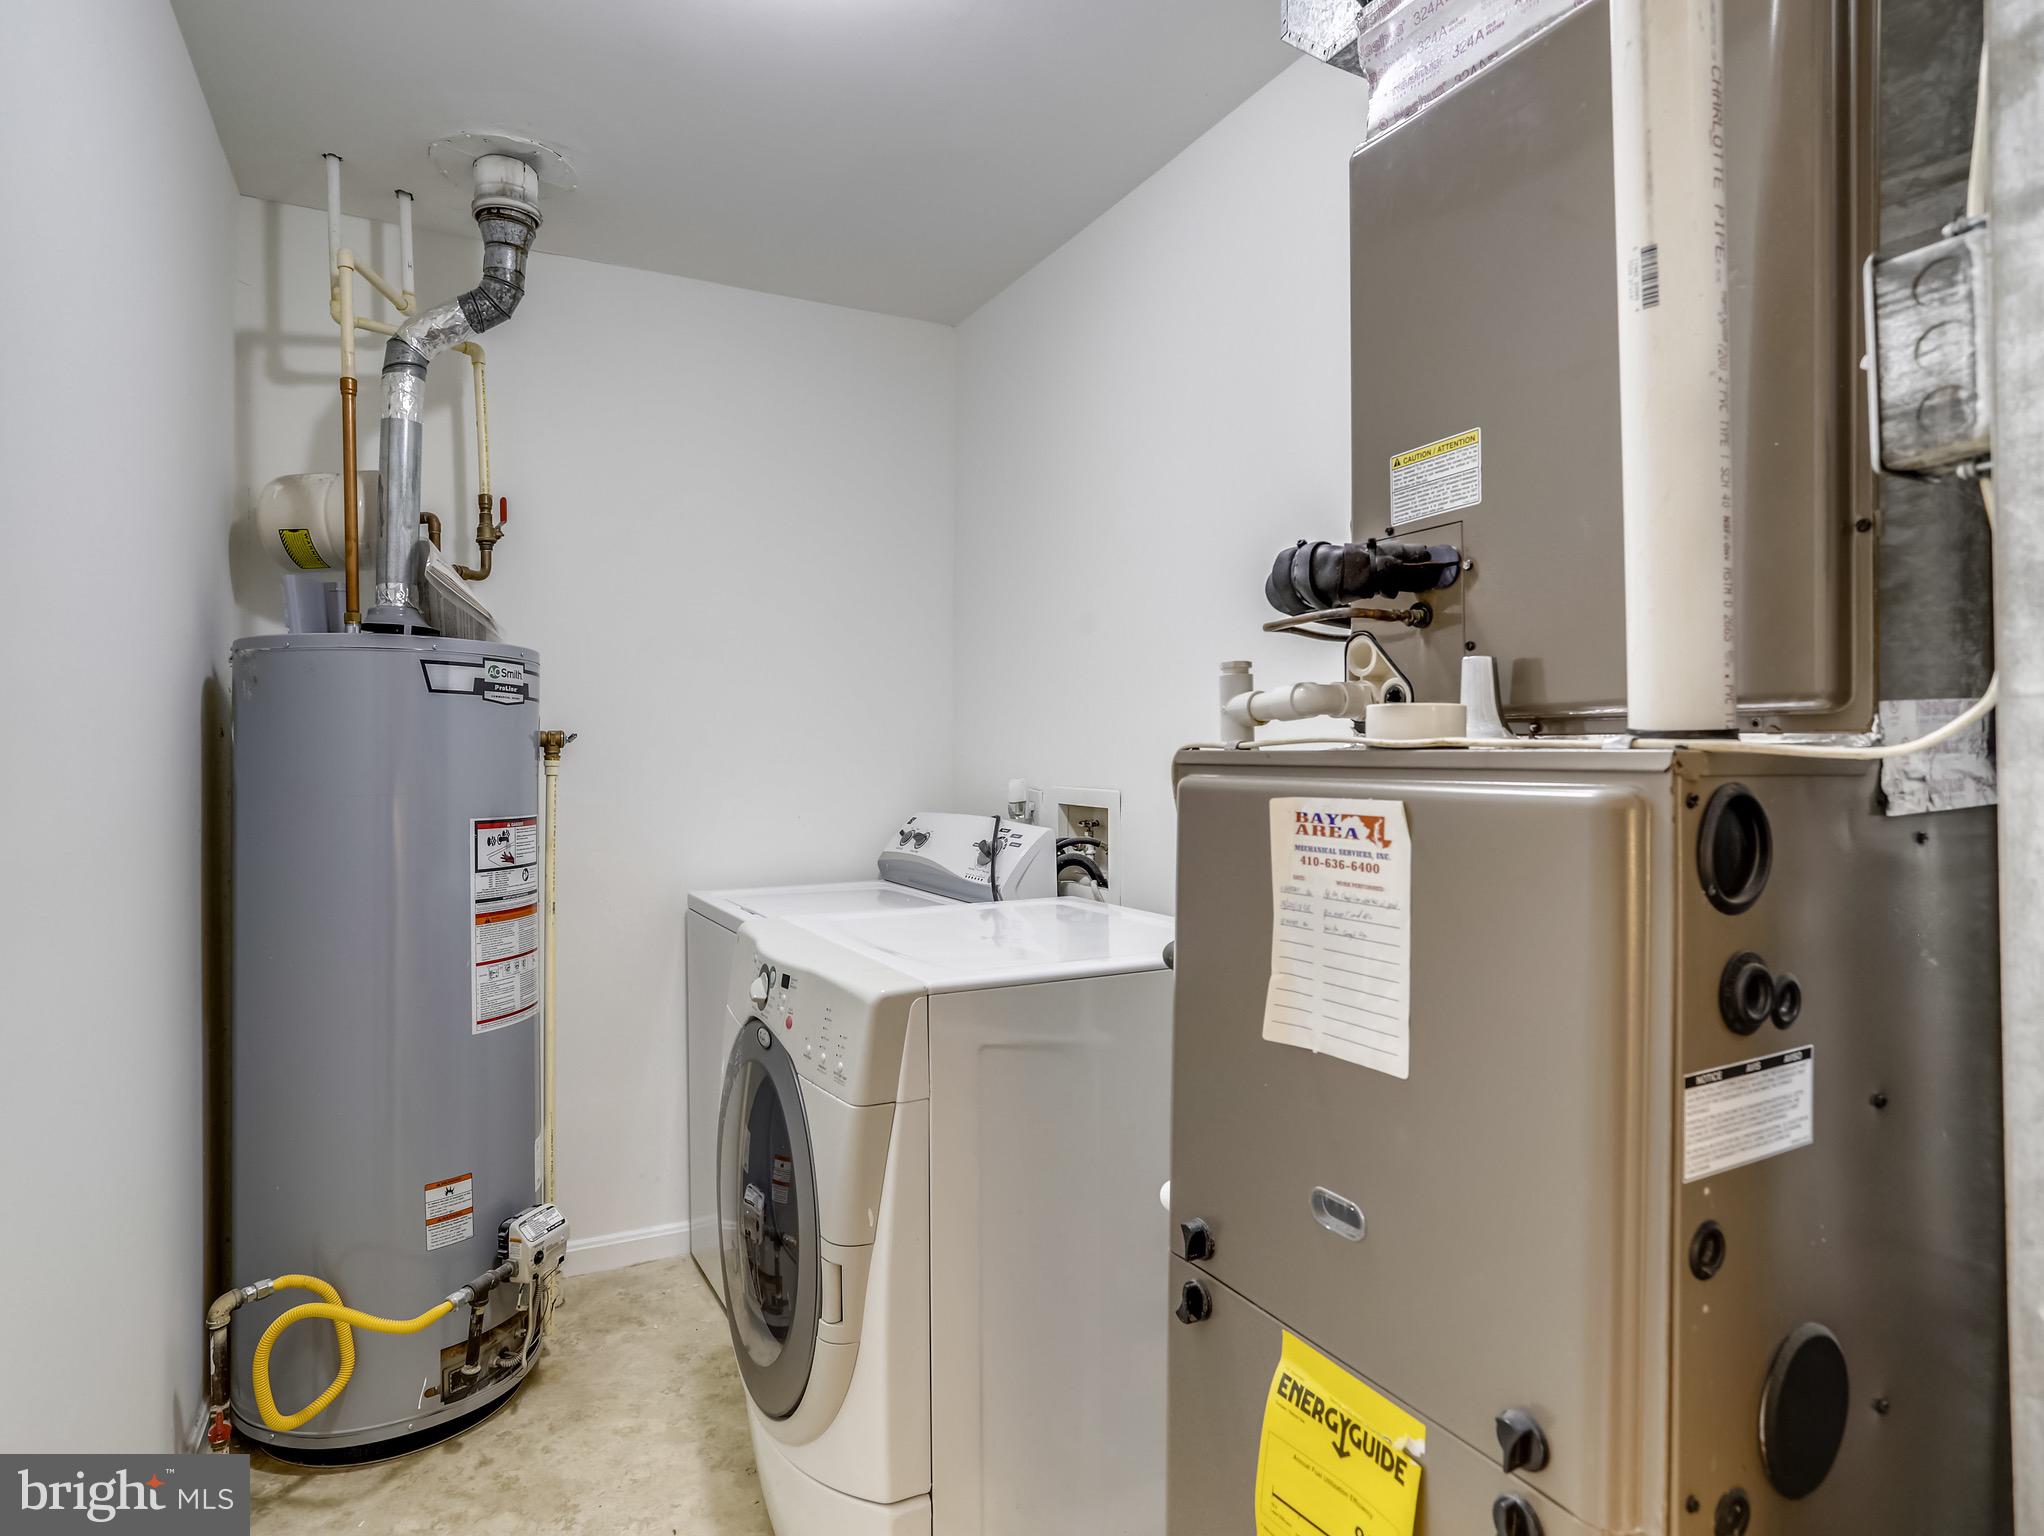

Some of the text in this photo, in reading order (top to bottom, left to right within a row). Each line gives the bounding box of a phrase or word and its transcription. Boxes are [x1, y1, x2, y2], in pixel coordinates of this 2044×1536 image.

[1452, 29, 1485, 59] 324A
[1711, 65, 1725, 190] CHARLOTTE
[1714, 204, 1726, 259] PIPE
[1403, 451, 1431, 465] CAUTION
[1437, 434, 1476, 453] ATTENTION
[1295, 824, 1360, 840] AREA
[1296, 811, 1340, 825] BAY
[1295, 845, 1337, 855] MECHANICAL
[1300, 855, 1380, 874] 410-636-6400
[1277, 1372, 1408, 1487] ENERGYGUIDE
